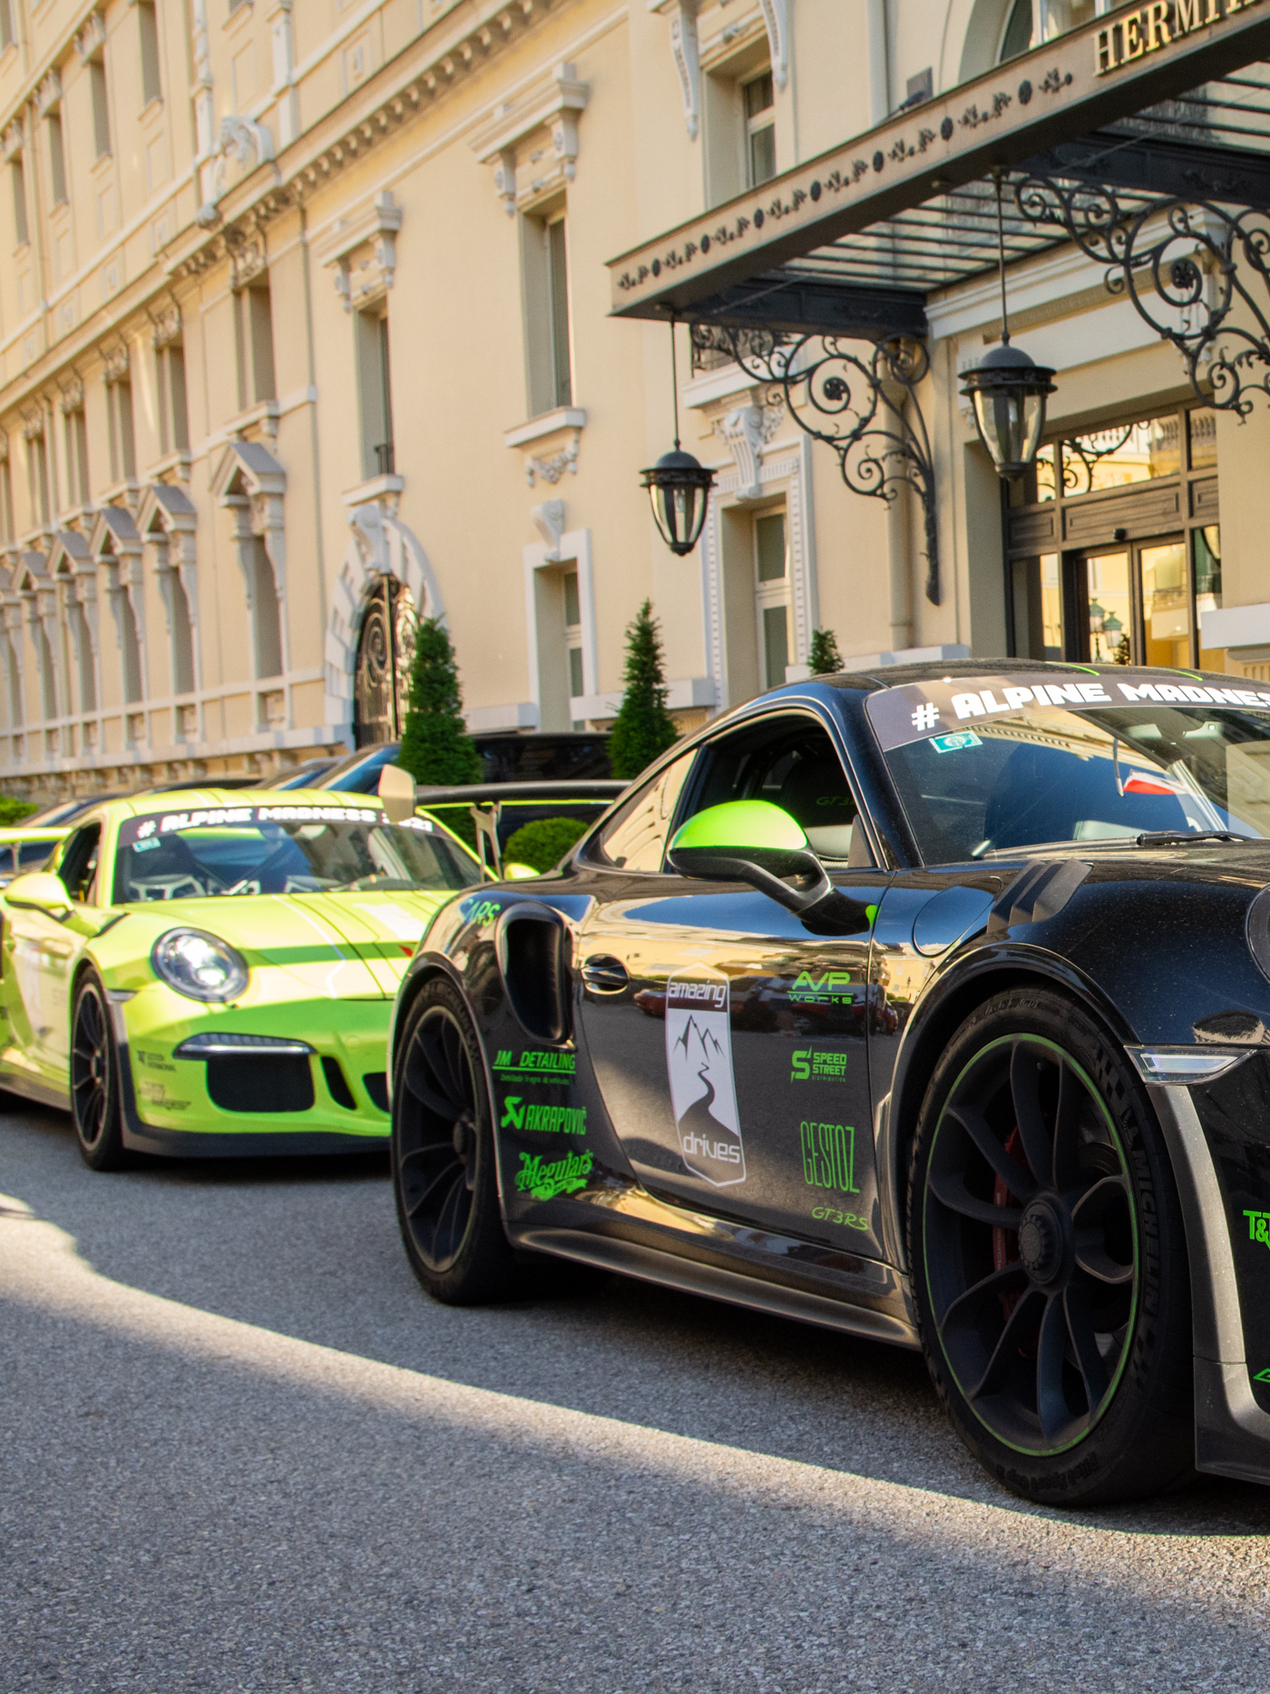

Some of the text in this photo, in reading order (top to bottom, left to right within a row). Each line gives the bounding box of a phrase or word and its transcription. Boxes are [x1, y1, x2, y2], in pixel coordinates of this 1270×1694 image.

[911, 702, 940, 731] #
[951, 683, 1112, 720] ALPINE
[816, 795, 856, 806] GT3
[160, 808, 253, 833] ALPINE
[258, 806, 377, 824] MADNESS
[791, 970, 851, 992] AVP
[668, 980, 727, 1008] amazing
[519, 1051, 576, 1070] DETAILING
[812, 1064, 846, 1076] STREET
[813, 1052, 848, 1065] SPEED
[683, 1132, 741, 1164] drives
[800, 1120, 860, 1194] GESTOZ
